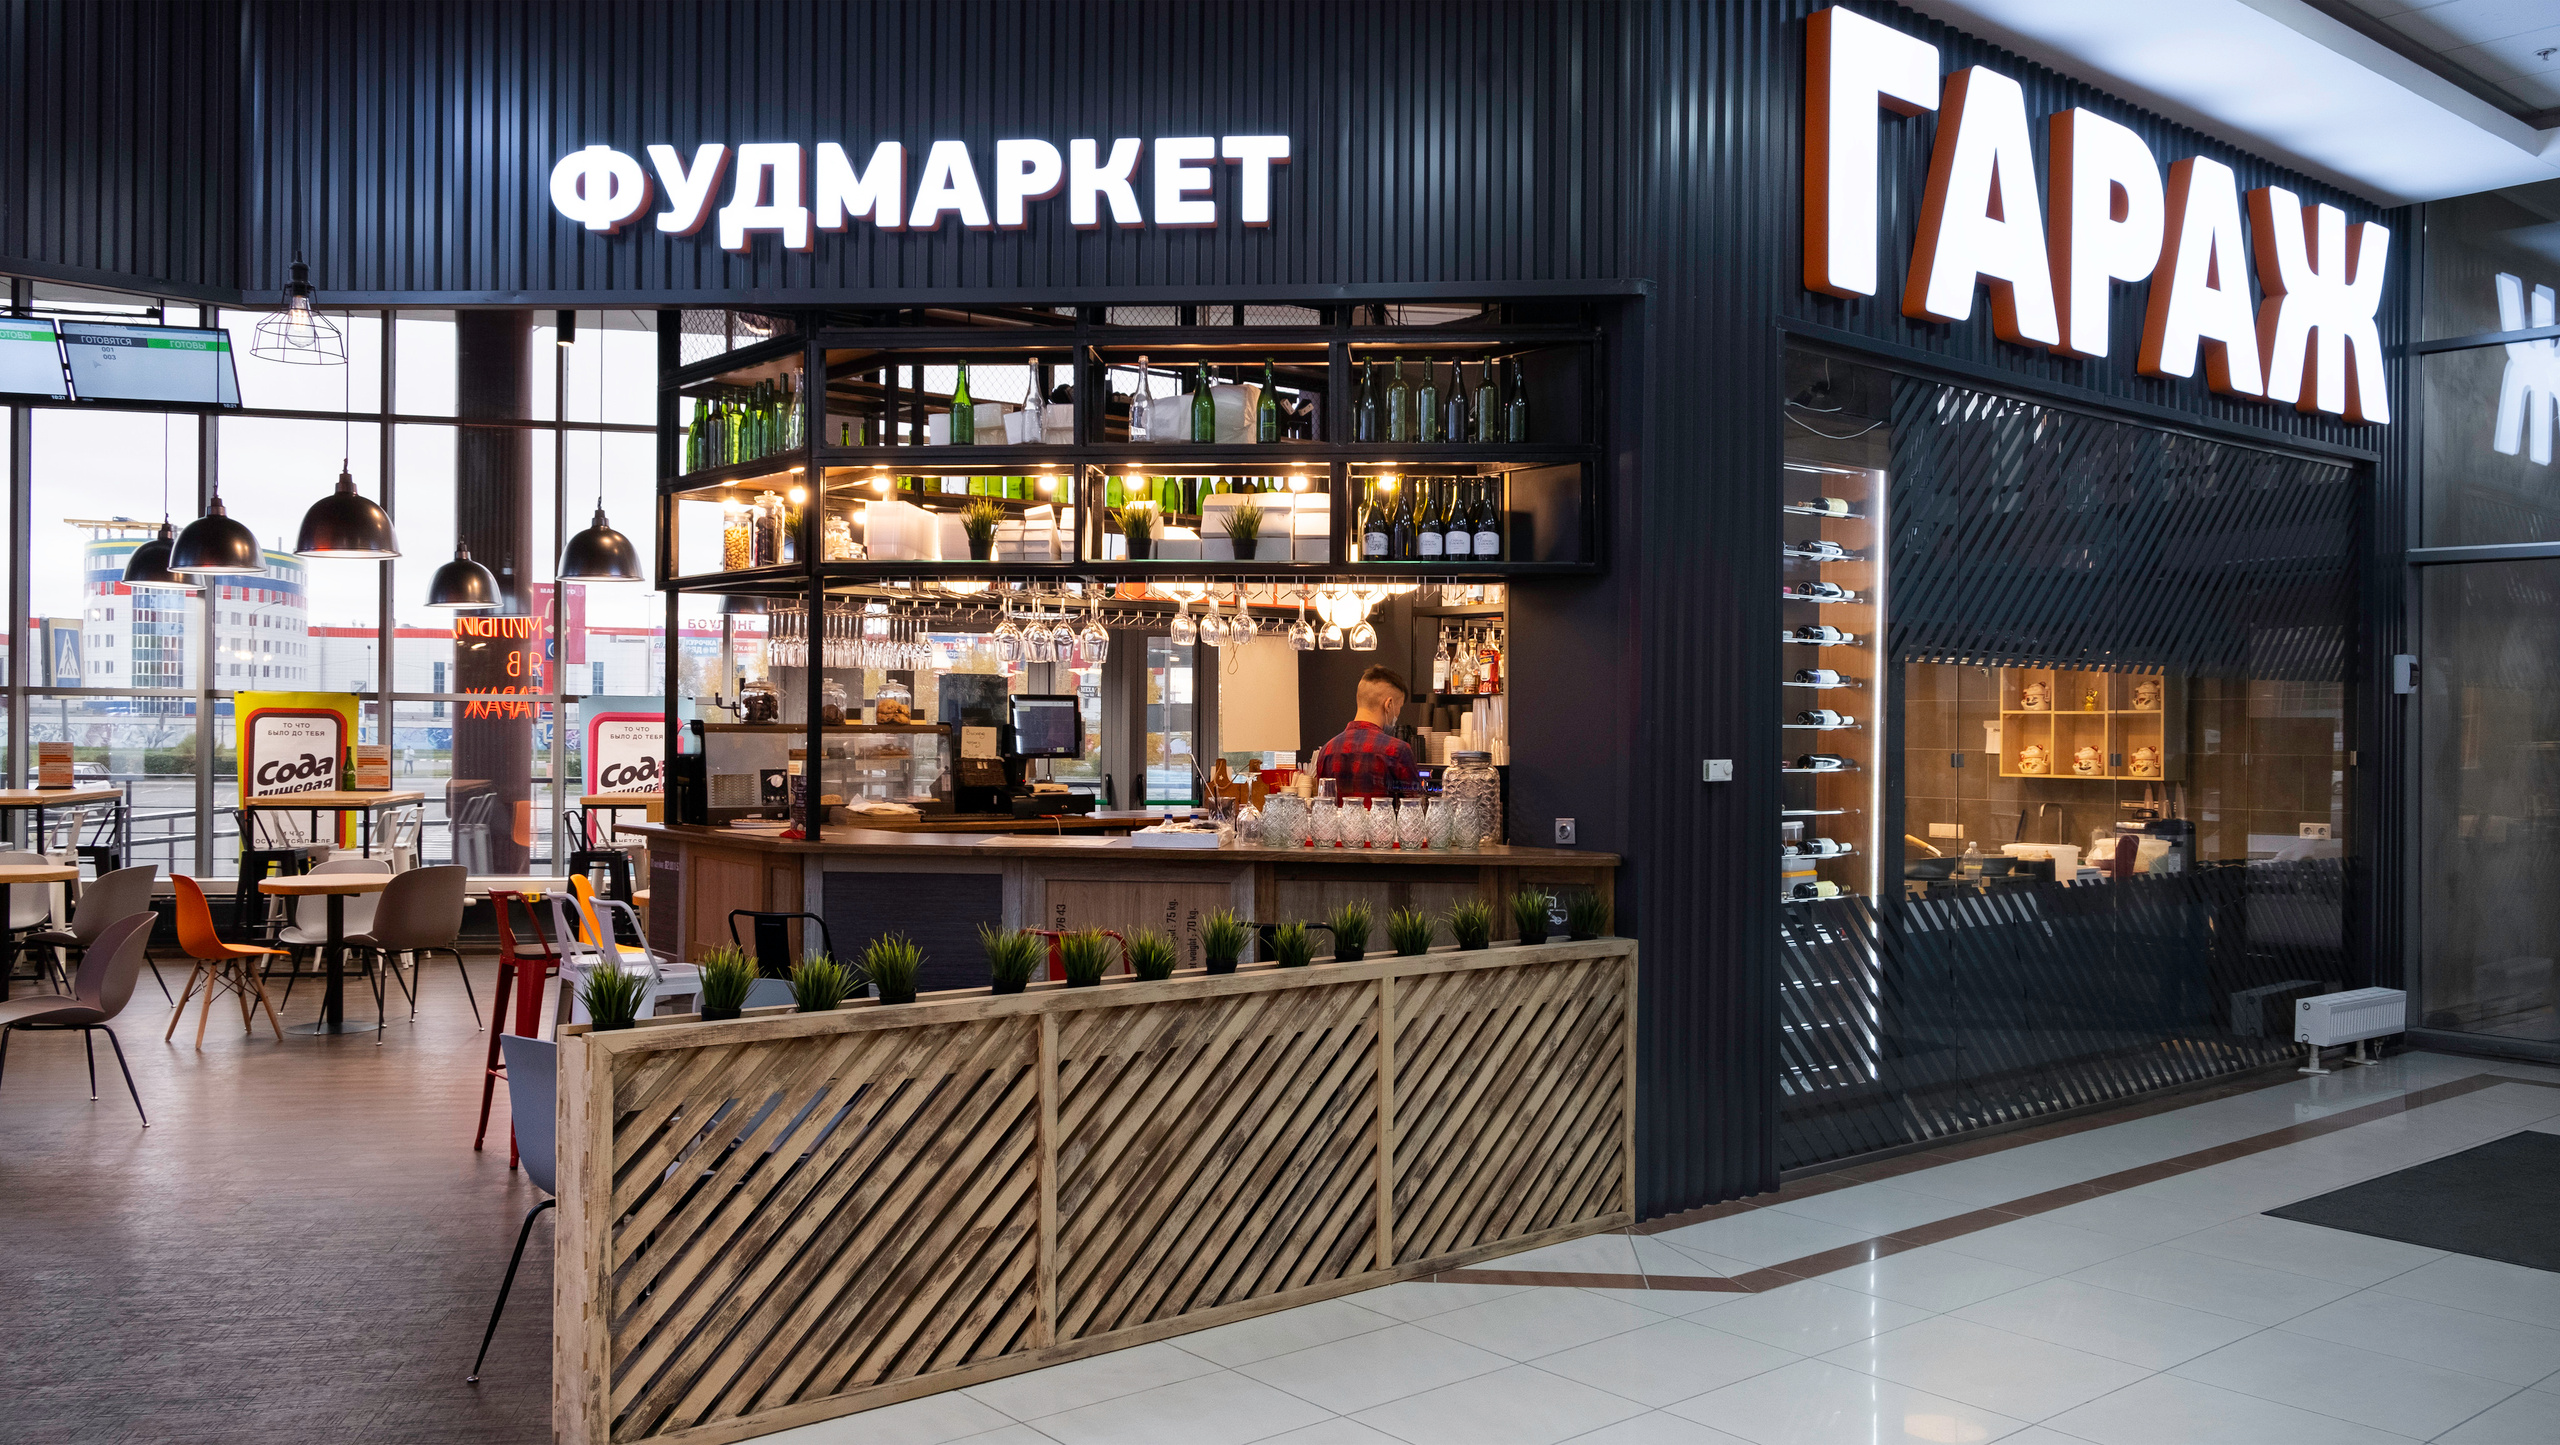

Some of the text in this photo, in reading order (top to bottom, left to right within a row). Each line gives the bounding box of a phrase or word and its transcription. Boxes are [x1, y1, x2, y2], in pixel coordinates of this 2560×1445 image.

[549, 134, 1291, 251] ФУДМАРКЕТ
[1806, 4, 2391, 426] ГАРАЖ
[80, 335, 132, 346] ГОТОВЯТСЯ
[169, 340, 207, 350] ГОТОВЫ
[256, 753, 334, 786] Сода
[1166, 898, 1179, 911] kg.
[1166, 912, 1177, 923] 75
[1187, 907, 1200, 920] kg.
[1186, 921, 1197, 933] 70
[1187, 938, 1200, 962] weight
